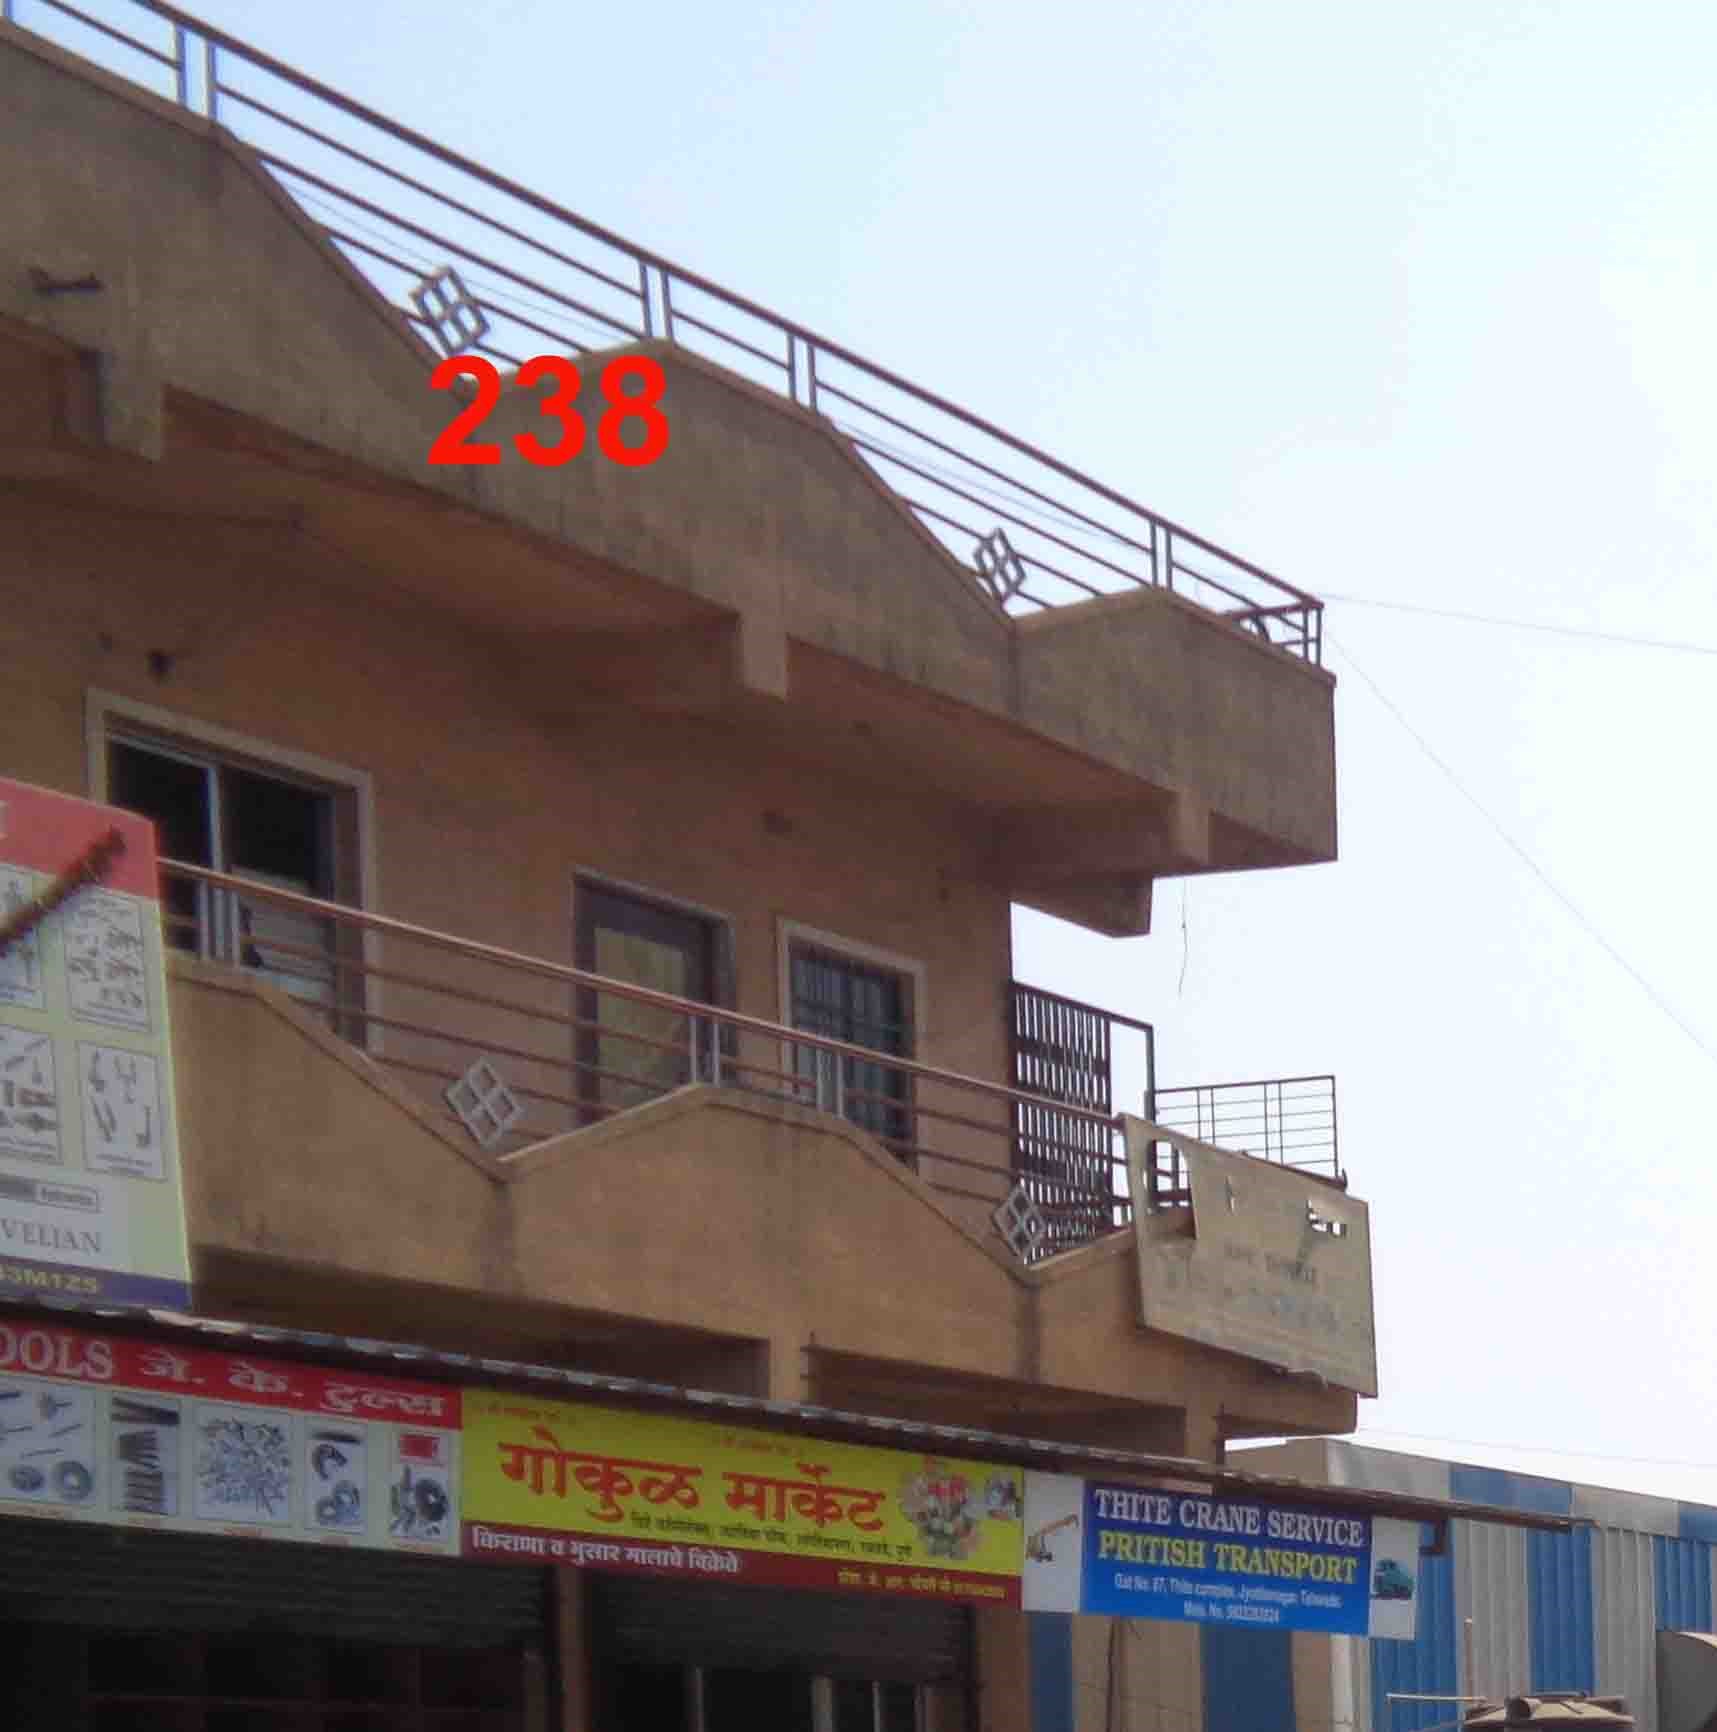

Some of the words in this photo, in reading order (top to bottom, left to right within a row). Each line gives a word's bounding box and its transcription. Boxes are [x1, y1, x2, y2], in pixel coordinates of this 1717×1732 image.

[497, 1424, 703, 1523] गोकुळ
[722, 1461, 886, 1531] मार्केट
[471, 1525, 546, 1556] किराणा
[550, 1537, 566, 1556] व
[568, 1539, 621, 1566] भुसार
[1095, 1489, 1170, 1525] THITE
[1179, 1500, 1260, 1536] CRANE
[1267, 1510, 1364, 1547] SERVICE
[1097, 1530, 1206, 1569] PRITISH
[1213, 1543, 1359, 1584] TRANSPORT
